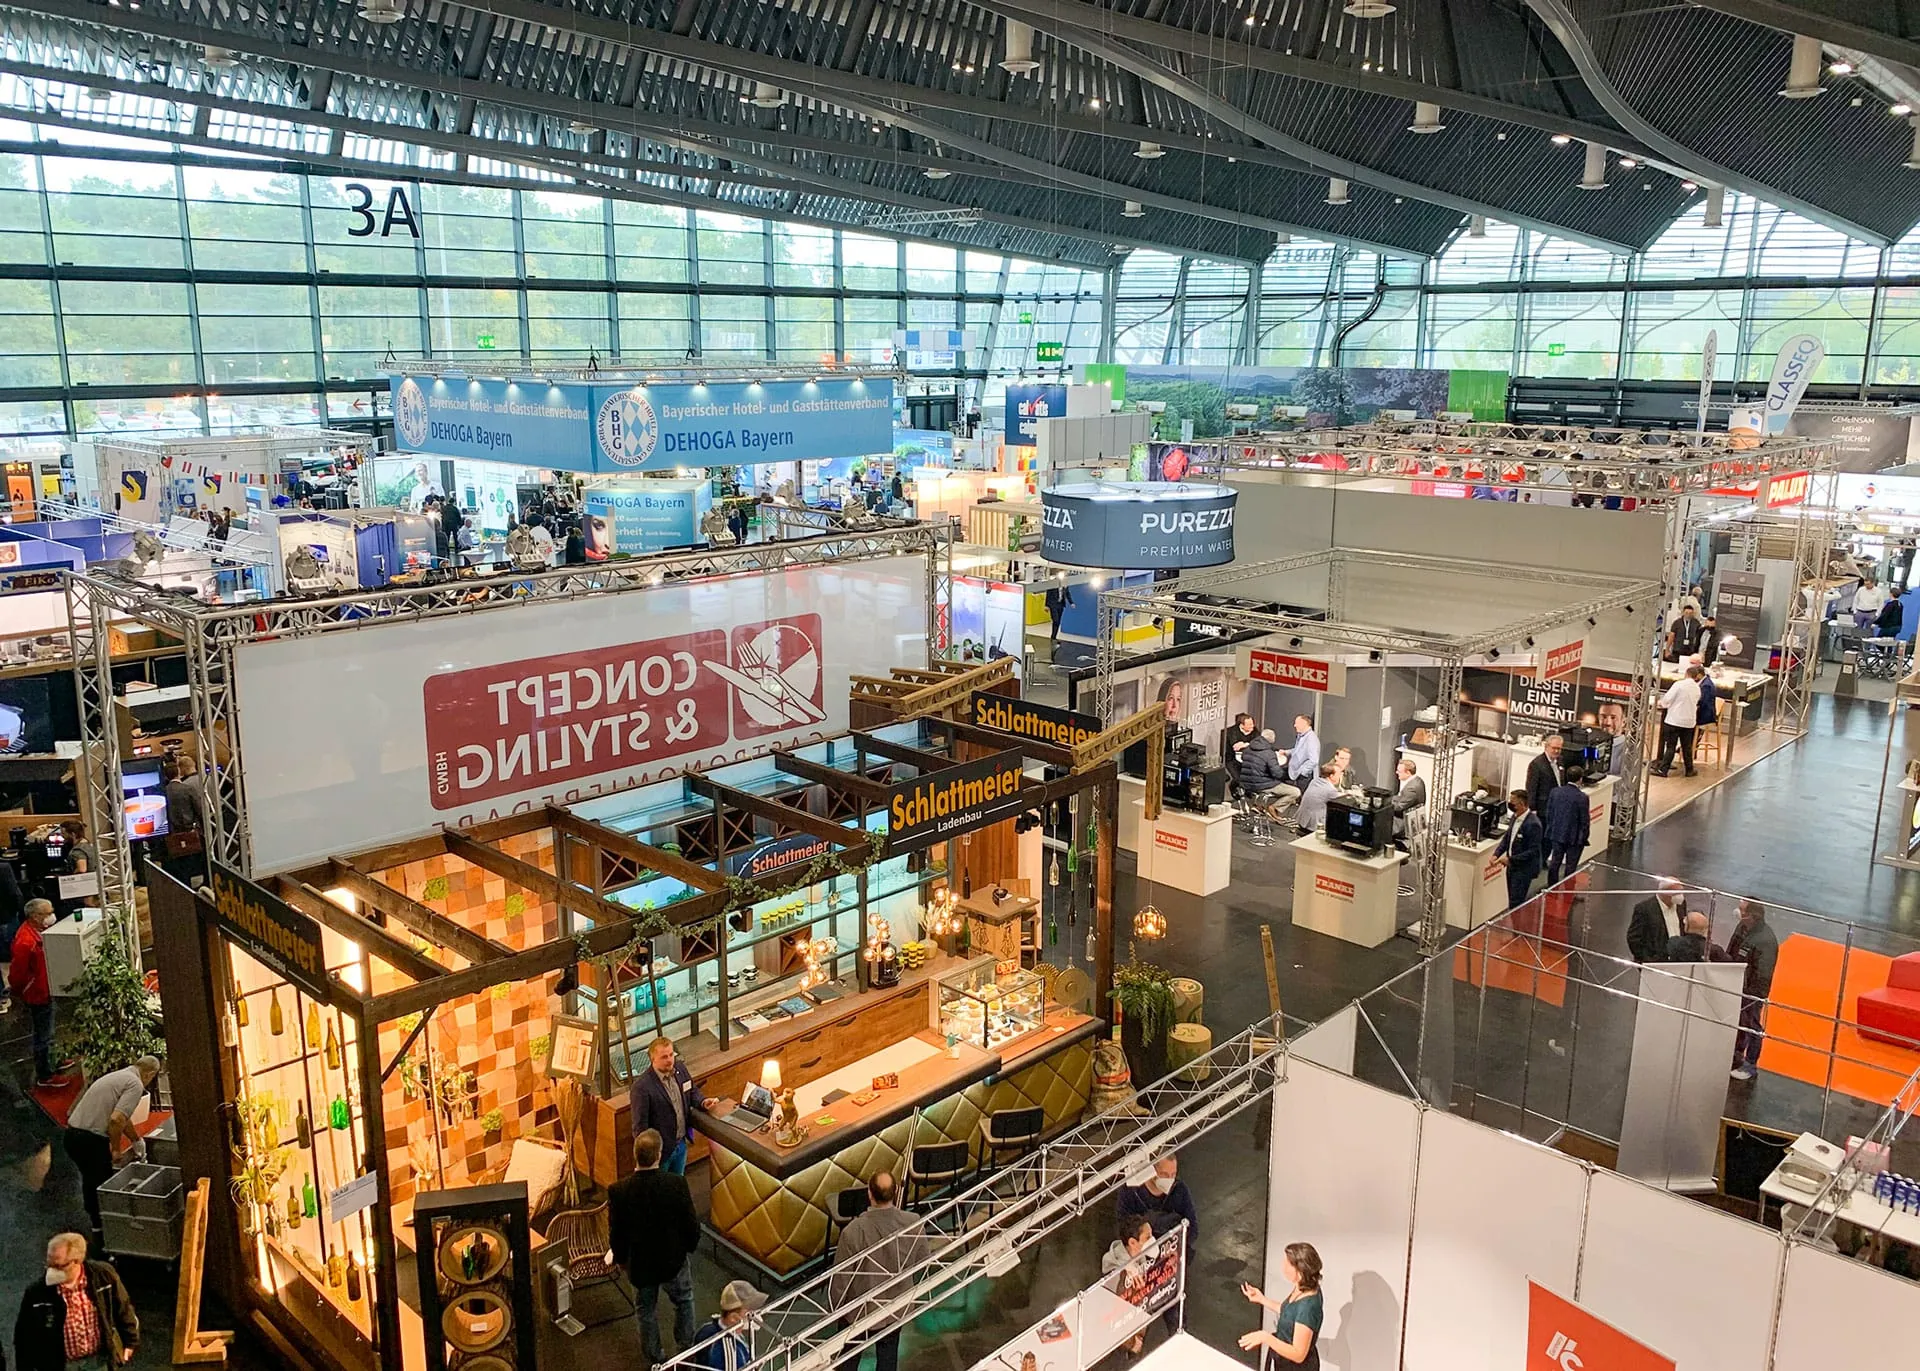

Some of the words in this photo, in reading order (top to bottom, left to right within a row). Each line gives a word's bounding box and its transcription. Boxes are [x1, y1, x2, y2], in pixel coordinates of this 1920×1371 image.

[345, 183, 421, 238] 3A
[1767, 339, 1819, 411] CLASSEQ
[429, 396, 468, 414] Bayerischer
[469, 400, 493, 413] Hotel-
[494, 402, 509, 414] und
[510, 402, 589, 420] Gaststättenverband
[662, 402, 729, 421] Bayerischer
[732, 401, 766, 416] Hotel-
[769, 400, 789, 414] und
[793, 396, 889, 413] Gaststättenverband
[1831, 415, 1875, 425] GEMEINSAM
[431, 421, 474, 443] DEHOGA
[477, 426, 513, 450] Bayern
[664, 430, 736, 452] DEHOGA
[741, 428, 794, 452] Bayern
[1767, 475, 1807, 504] PALUX
[645, 497, 685, 511] Bayern
[615, 527, 643, 536] erheit
[1139, 507, 1233, 534] PUREZZA
[1046, 538, 1073, 552] WATER
[1140, 544, 1204, 557] PREMIUM
[1208, 538, 1233, 553] WATER
[1251, 658, 1327, 683] FRANKE
[1546, 647, 1582, 672] FRANKE
[1192, 680, 1223, 698] DIESER
[1519, 674, 1570, 694] DIESER
[1197, 694, 1218, 711] EINE
[1527, 689, 1561, 706] EINE
[1188, 705, 1226, 728] MOMENT
[1510, 700, 1575, 722] MOMENT
[892, 763, 1023, 832] Schlattmeier
[937, 810, 982, 833] Ladenbau
[752, 839, 830, 874] Schlattmeier
[214, 872, 317, 975] Schlattmeier
